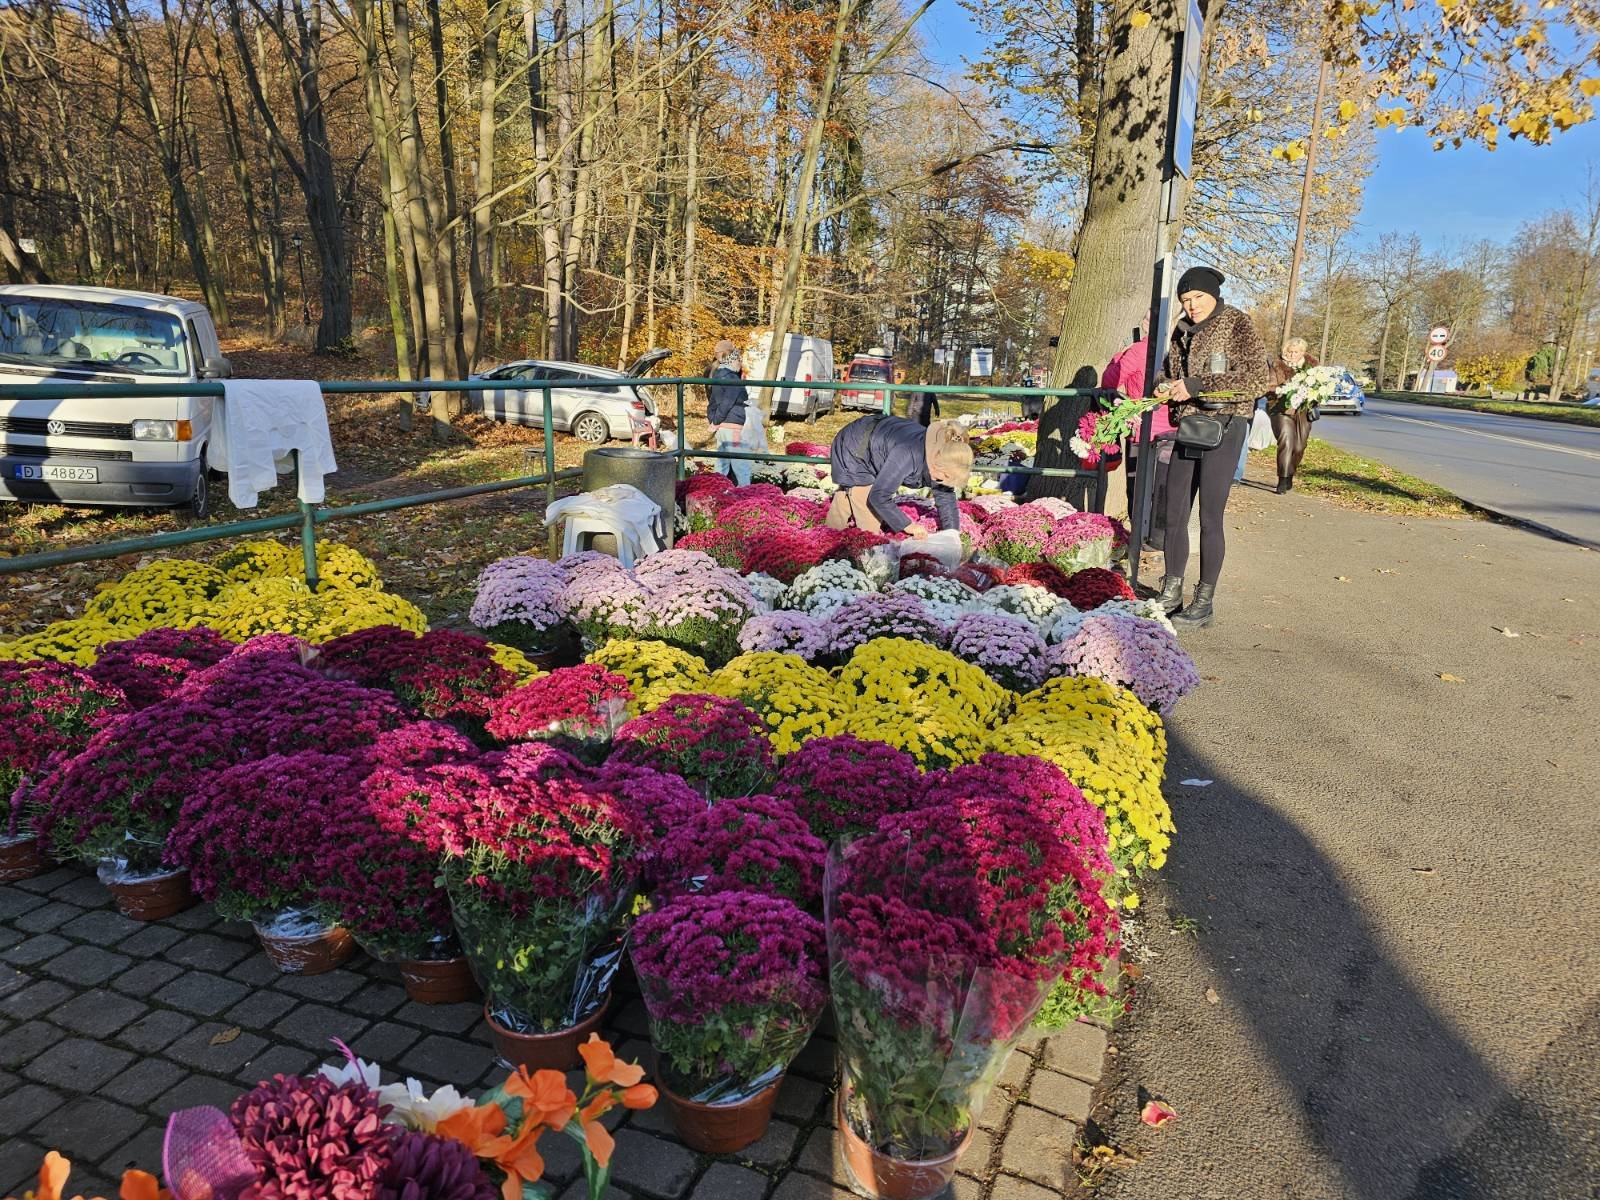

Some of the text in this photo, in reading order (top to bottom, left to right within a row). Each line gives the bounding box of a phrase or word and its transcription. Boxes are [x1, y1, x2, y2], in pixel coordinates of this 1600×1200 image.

[1430, 349, 1443, 358] 40
[47, 420, 65, 434] VW
[50, 467, 93, 480] 48825
